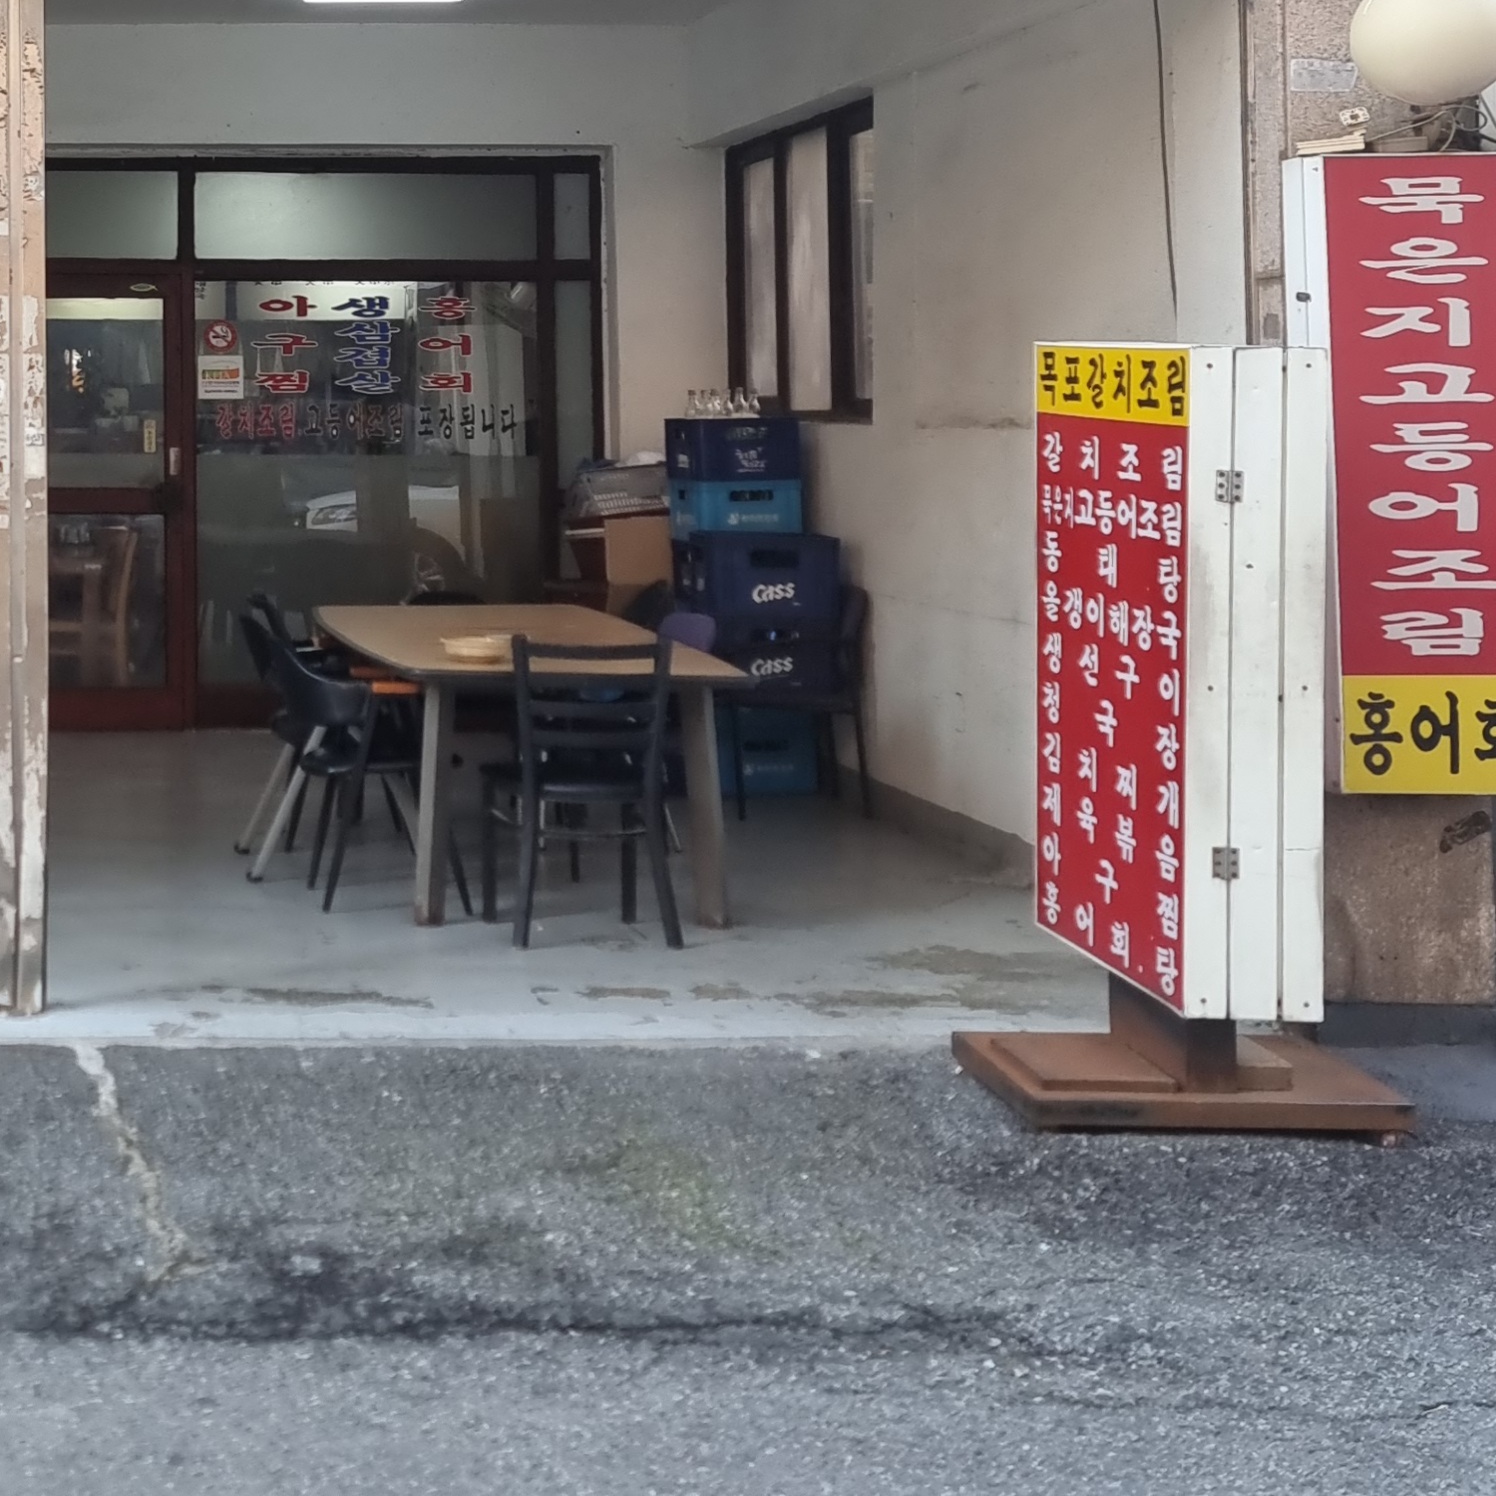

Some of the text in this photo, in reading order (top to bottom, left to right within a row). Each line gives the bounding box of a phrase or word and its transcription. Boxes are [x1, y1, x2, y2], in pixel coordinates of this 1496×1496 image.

[251, 295, 318, 393] 아구찜
[332, 295, 402, 395] 생삼겹살
[418, 295, 477, 394] 홍어회
[1039, 351, 1186, 417] 목포갈치조림
[215, 404, 297, 440] 갈치조림
[417, 403, 518, 441] 포장됩니다
[1041, 431, 1184, 492] 갈치조림
[1357, 176, 1496, 656] 묵은지고등어조림
[1041, 531, 1183, 604] 동태탕
[1041, 580, 1182, 661] 올갱이해장국
[1041, 632, 1181, 717] 생선구이
[1041, 681, 1180, 771] 청국장
[1041, 732, 1180, 830] 김치찌개
[1041, 782, 1180, 883] 제육볶음
[1041, 832, 1179, 940] 아구찜
